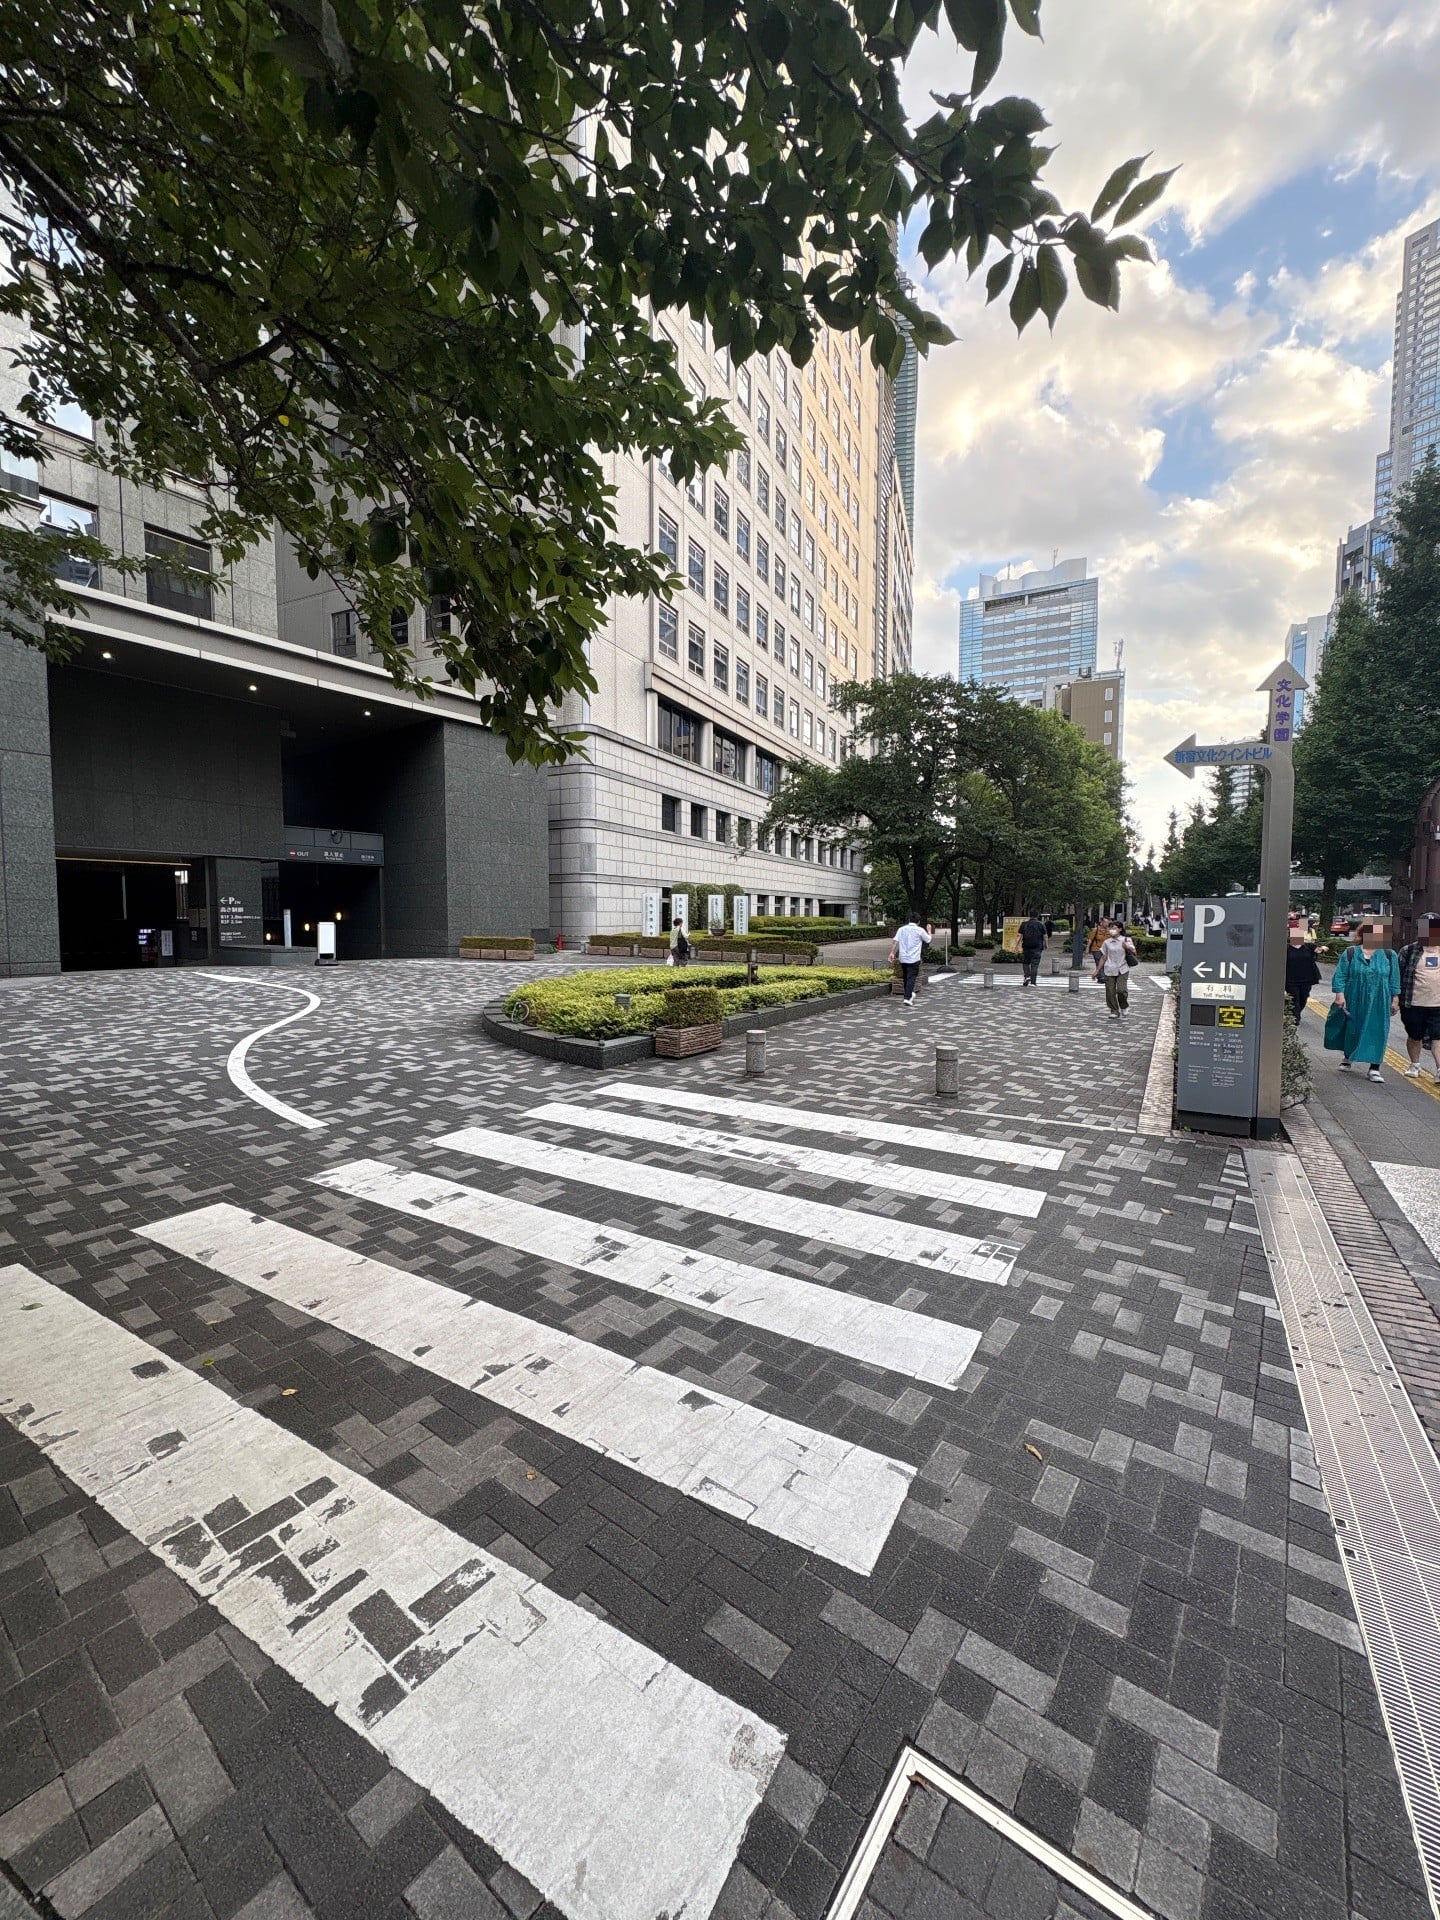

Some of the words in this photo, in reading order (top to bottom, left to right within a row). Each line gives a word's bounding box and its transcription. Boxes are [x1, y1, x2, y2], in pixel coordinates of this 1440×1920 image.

[1274, 678, 1292, 742] 文化学園
[1174, 746, 1273, 764] 新宿文化クイントビル
[228, 896, 235, 905] P
[1193, 904, 1226, 944] P
[1219, 961, 1247, 979] IN
[1217, 1005, 1245, 1028] 空
